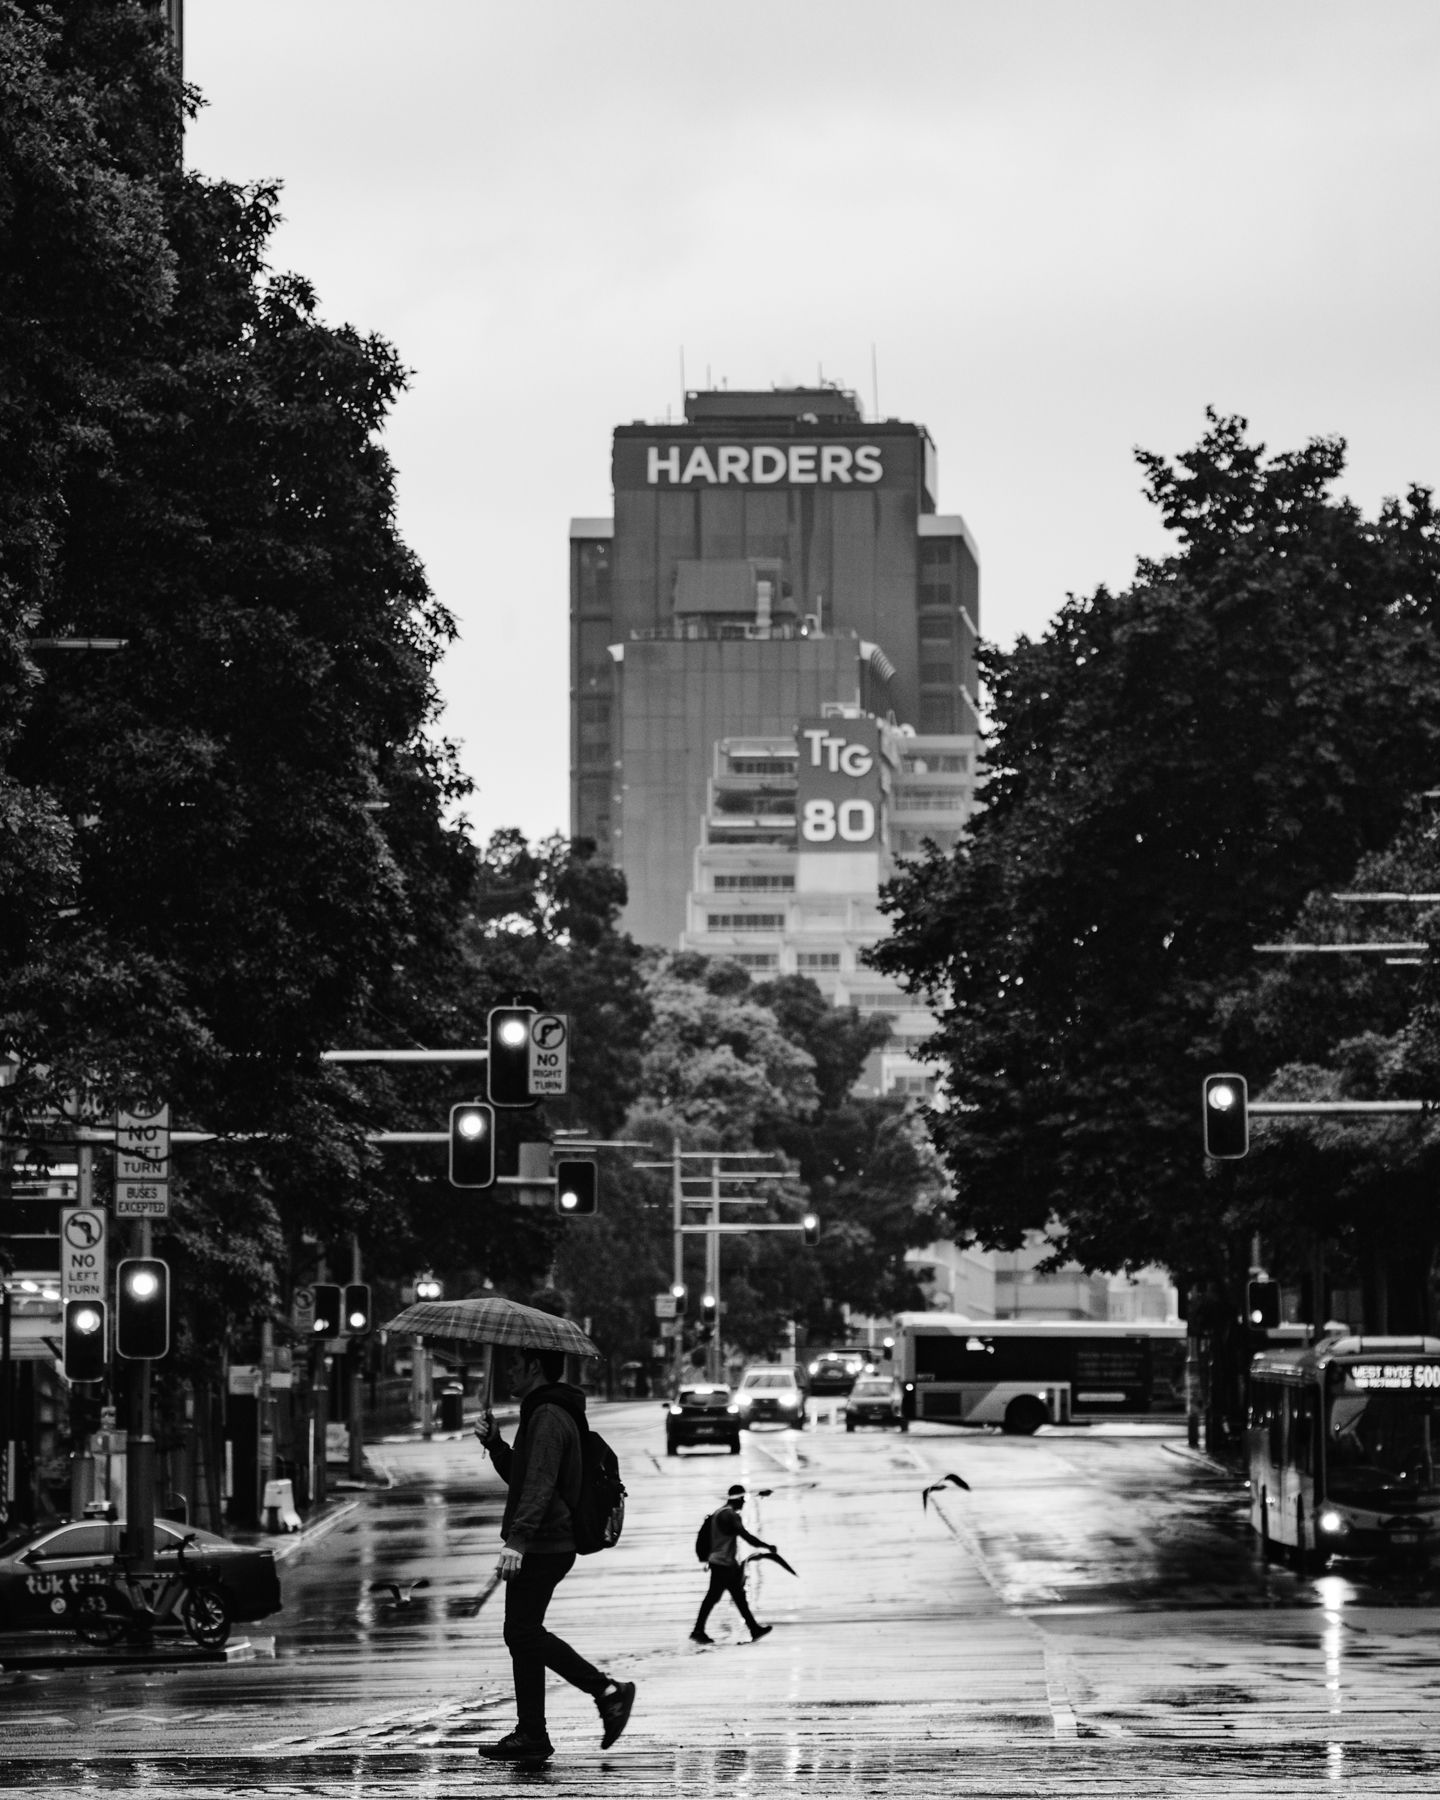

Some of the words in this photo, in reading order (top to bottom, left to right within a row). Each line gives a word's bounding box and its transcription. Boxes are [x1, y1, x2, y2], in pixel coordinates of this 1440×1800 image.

[647, 445, 884, 484] HARDERS
[803, 729, 873, 777] TTG
[802, 799, 875, 842] 80
[537, 1053, 559, 1067] NO
[535, 1081, 562, 1090] TURN
[128, 1125, 157, 1142] NO
[123, 1162, 162, 1173] TURN
[126, 1187, 158, 1199] BUSES
[118, 1202, 165, 1213] EXCEPTED
[71, 1254, 96, 1268] NO
[69, 1271, 99, 1281] LEFT
[68, 1284, 100, 1295] TURN
[1352, 1366, 1382, 1378] WEST
[1414, 1366, 1440, 1388] 500
[25, 1574, 64, 1594] tük
